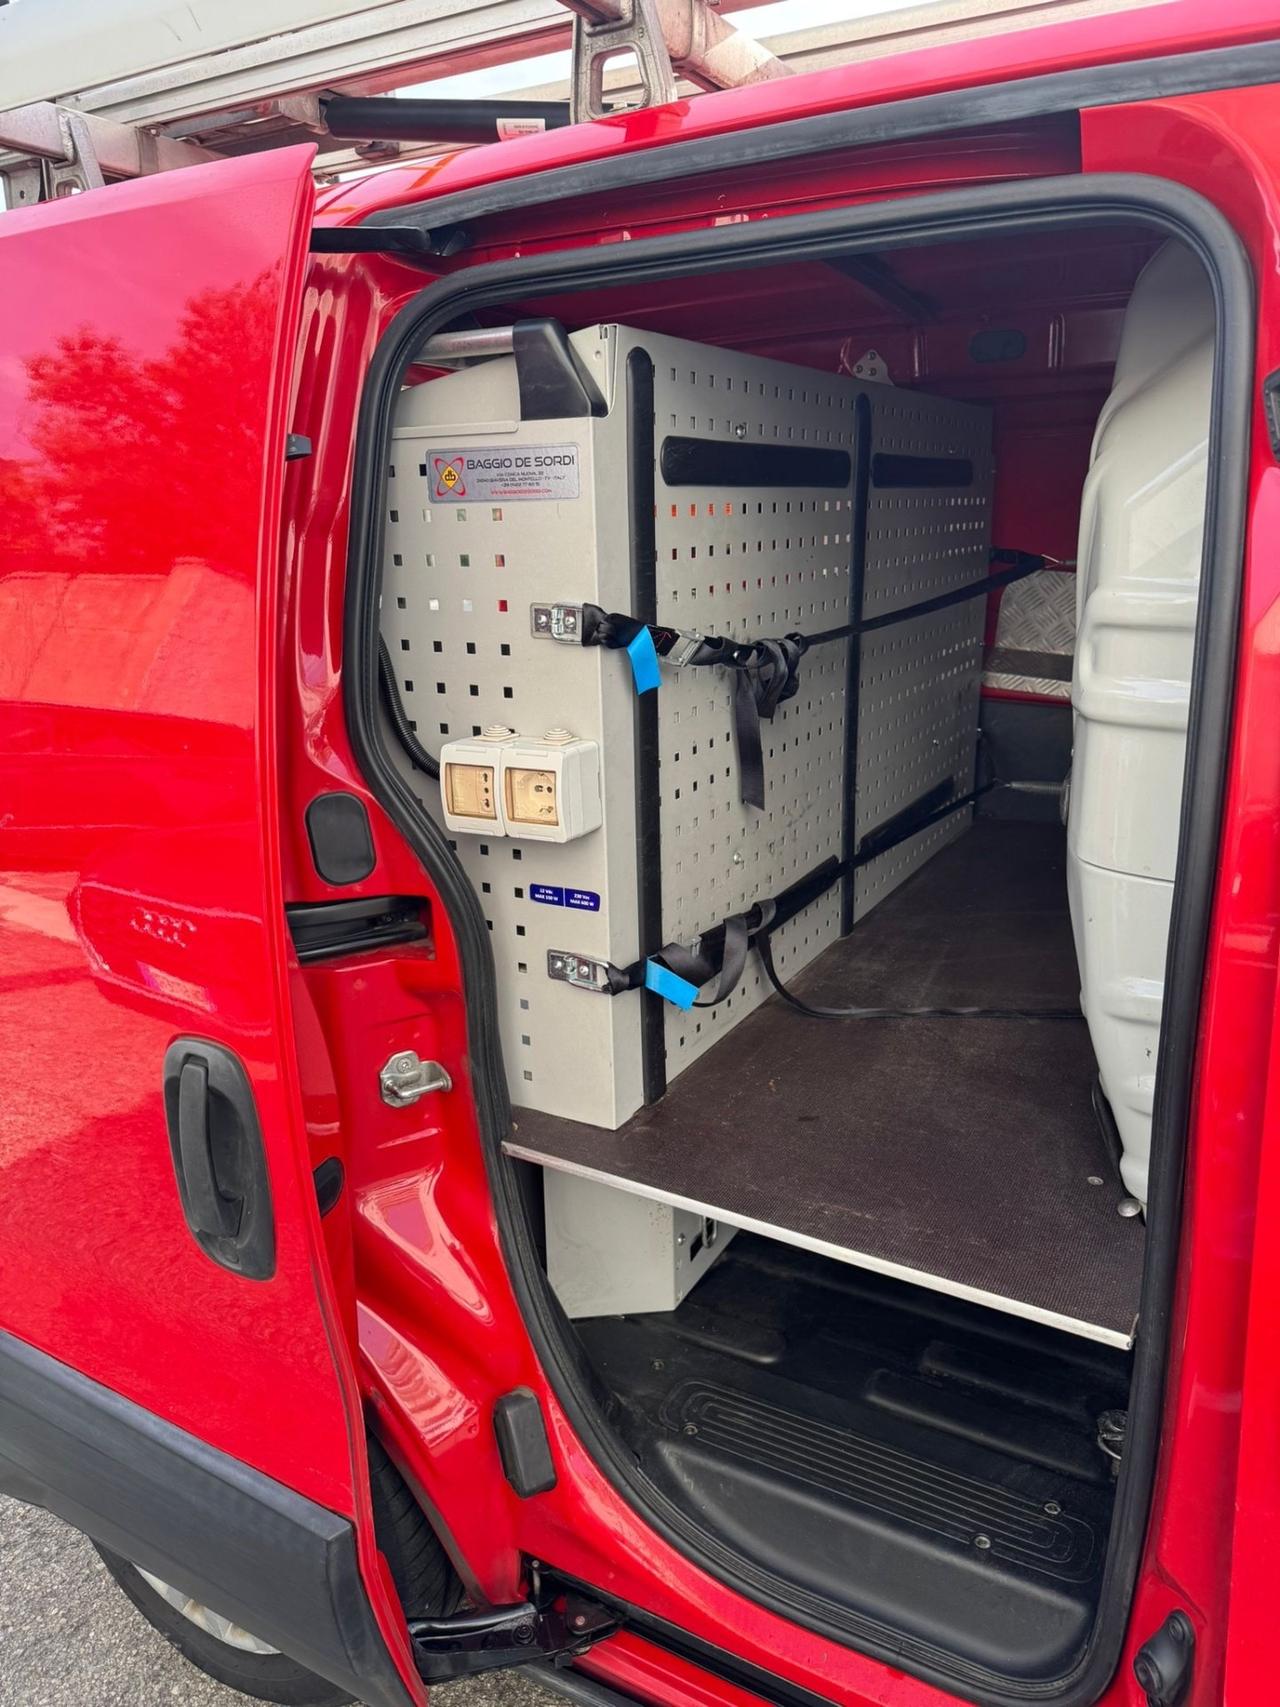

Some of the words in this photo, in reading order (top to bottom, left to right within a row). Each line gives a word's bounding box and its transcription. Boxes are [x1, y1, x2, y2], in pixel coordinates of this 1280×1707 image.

[466, 458, 512, 469] BAGGIO
[515, 457, 532, 468] DE
[534, 455, 575, 467] SORDI
